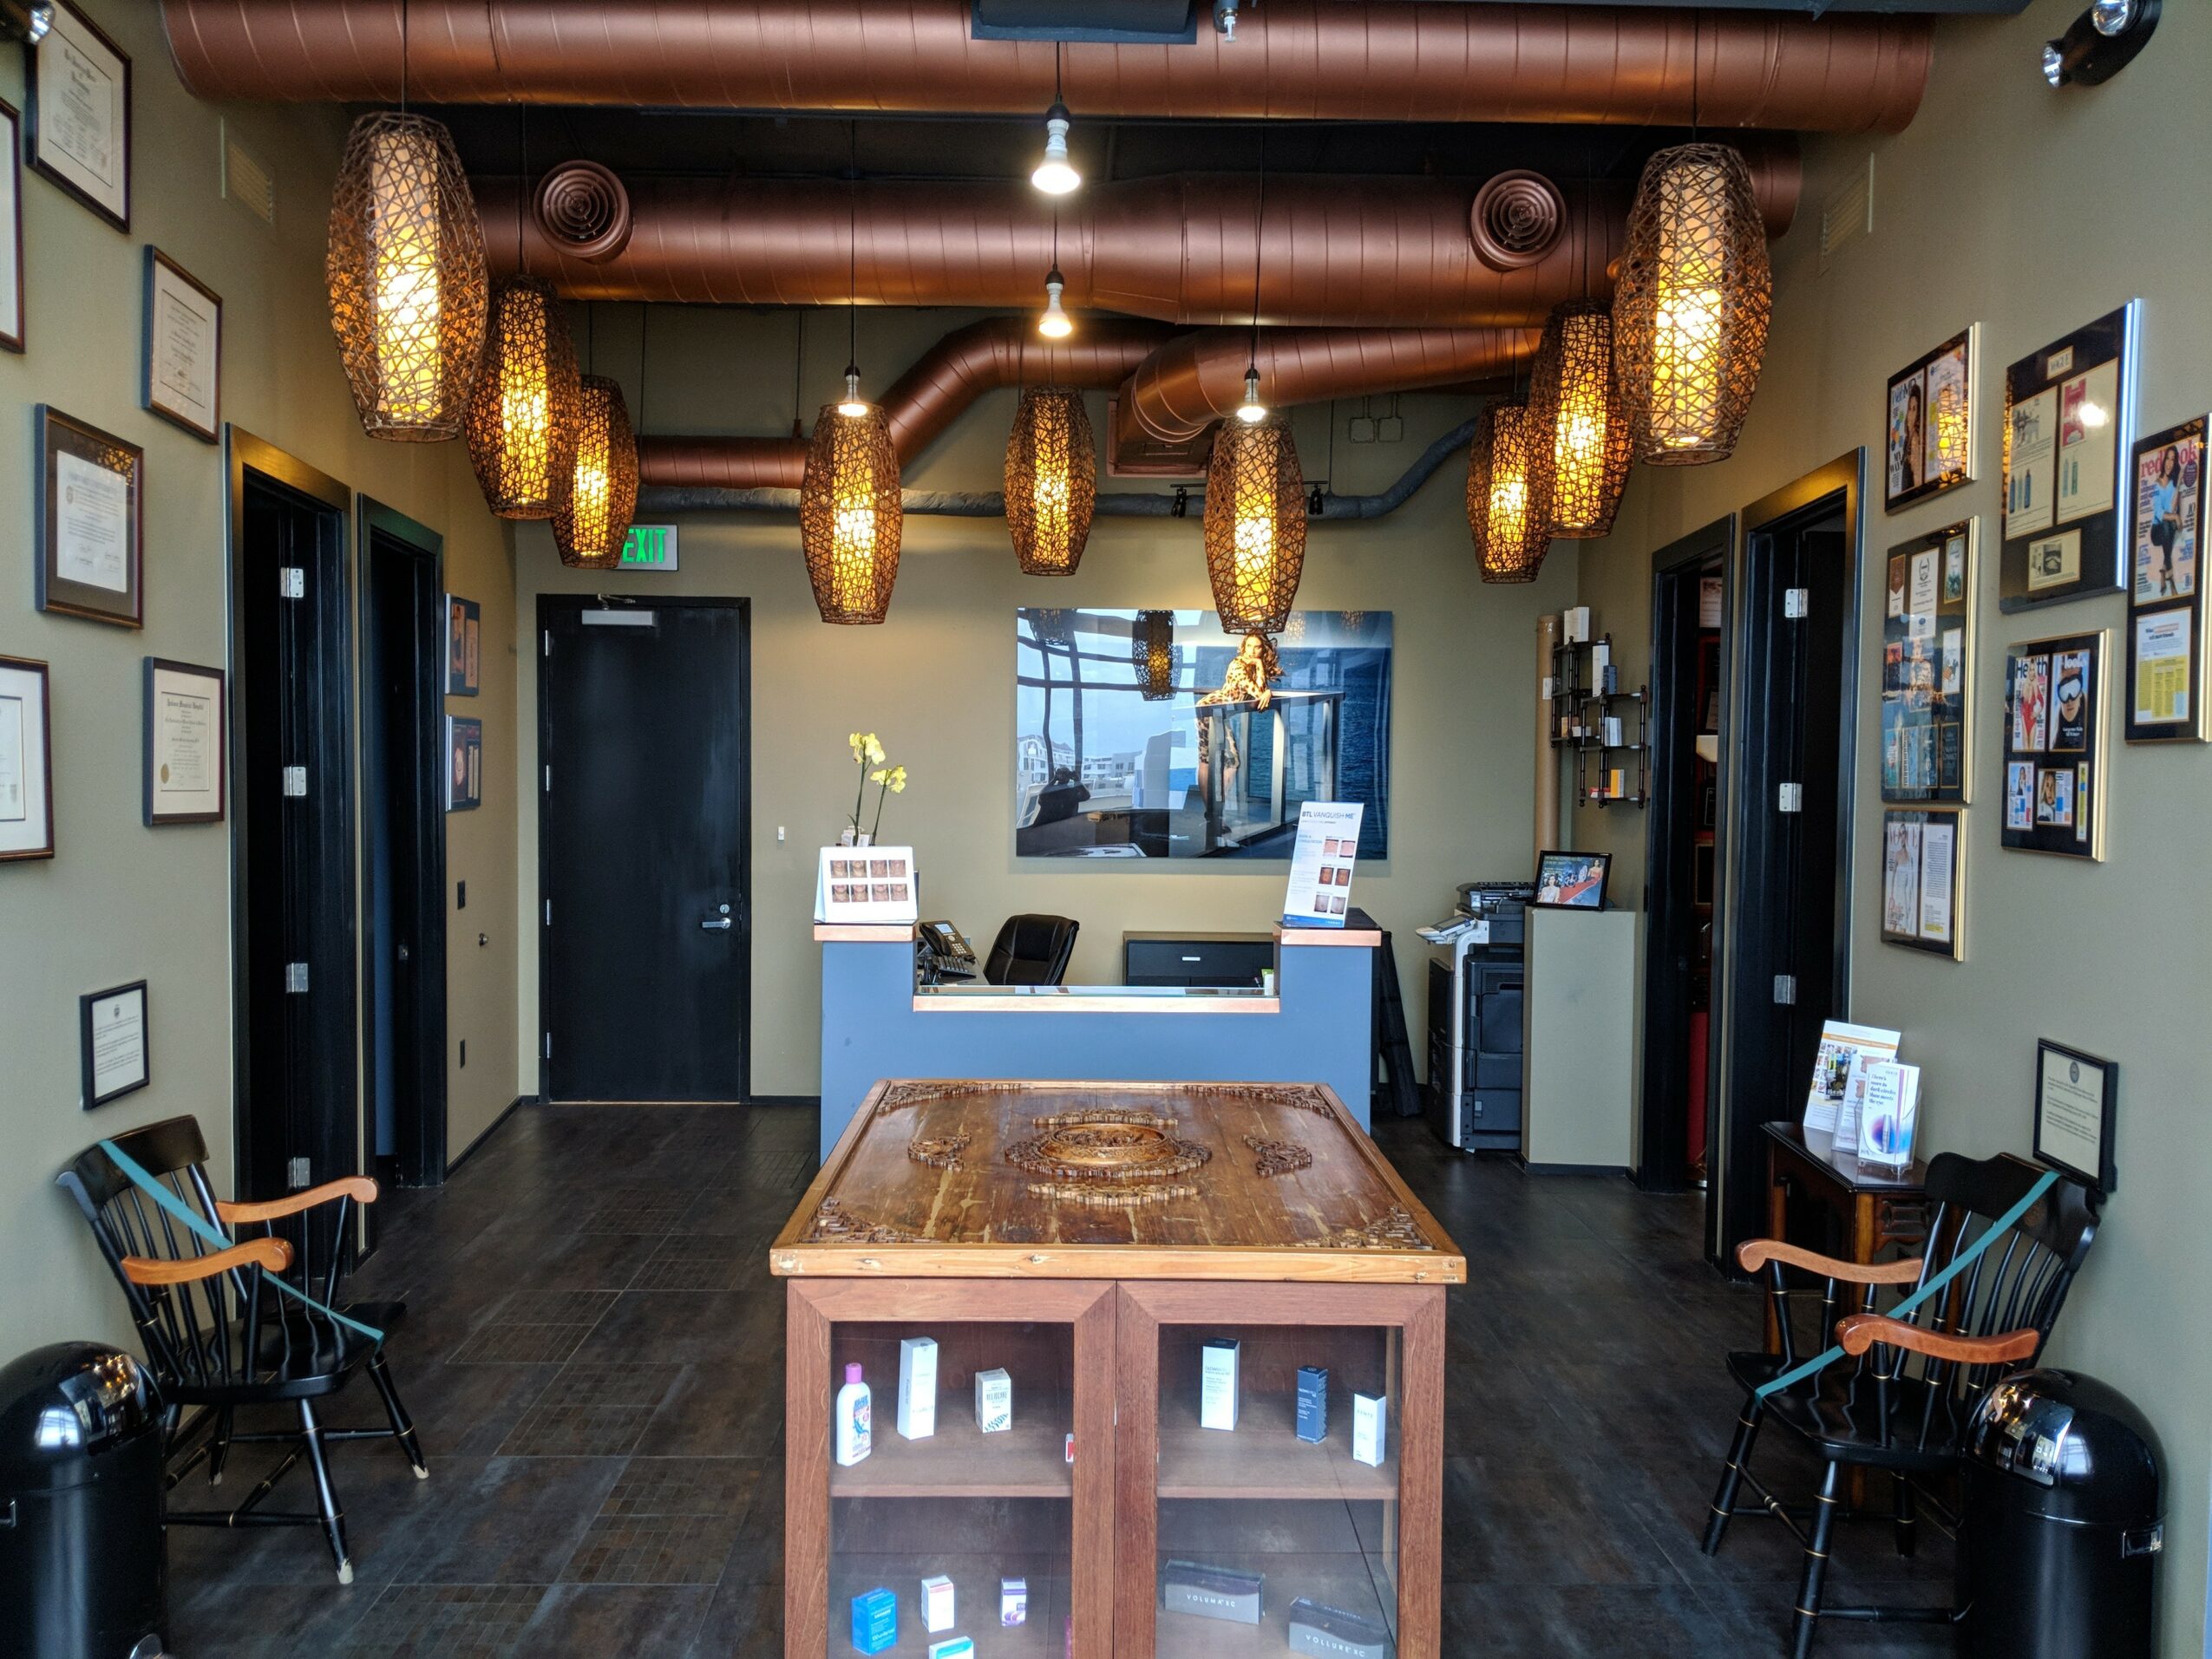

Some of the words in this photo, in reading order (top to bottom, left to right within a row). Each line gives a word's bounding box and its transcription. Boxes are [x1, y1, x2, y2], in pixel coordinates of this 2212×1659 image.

[2141, 439, 2198, 478] redok
[622, 528, 667, 563] EXIT
[2015, 656, 2048, 679] Heth
[1186, 1593, 1222, 1605] VOLUMA
[1225, 1599, 1235, 1608] XC
[1306, 1634, 1351, 1654] VOLLURE
[1354, 1649, 1365, 1658] XC
